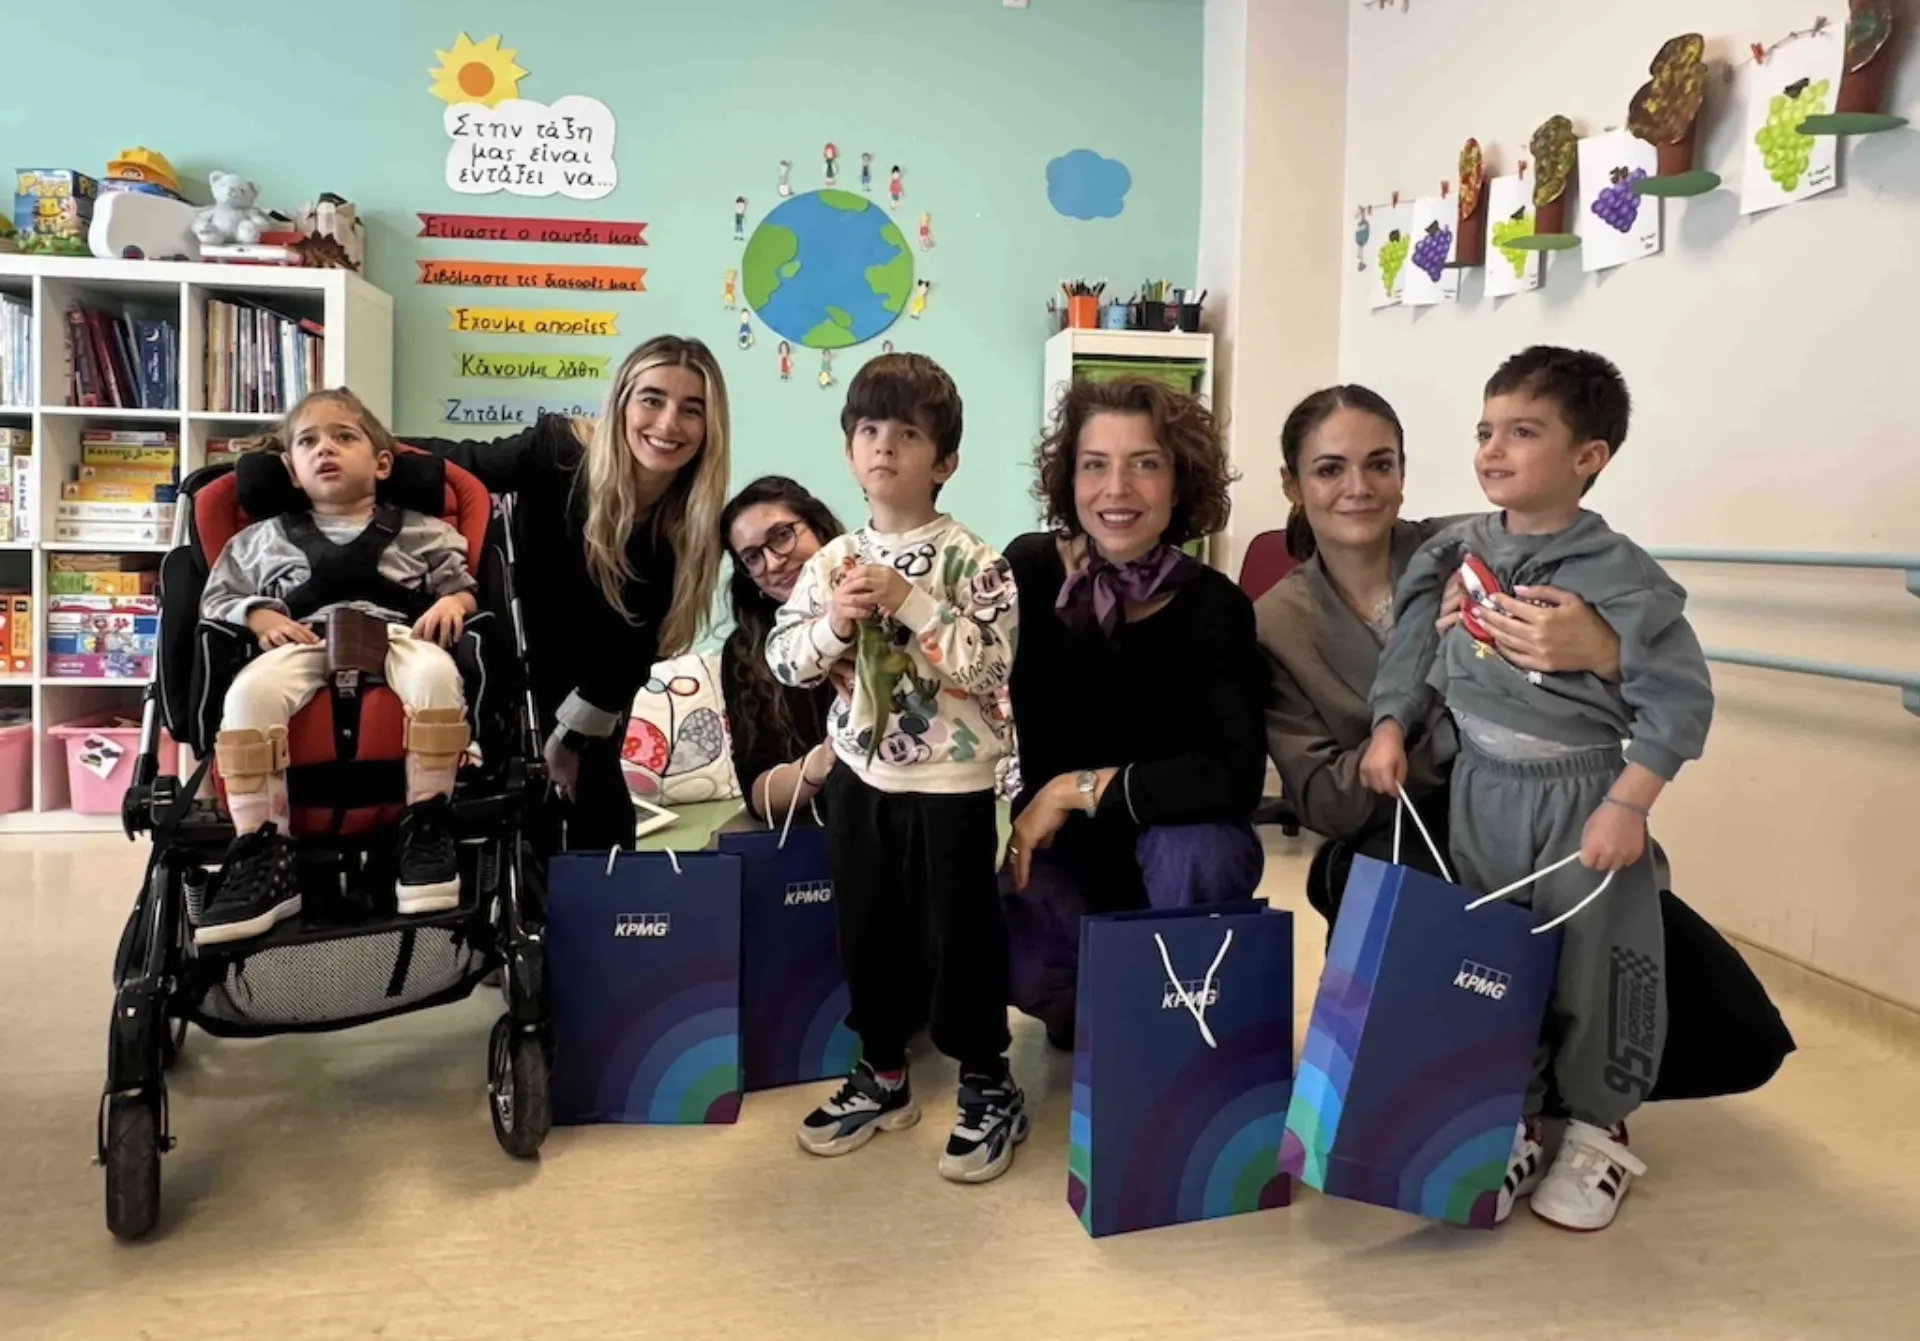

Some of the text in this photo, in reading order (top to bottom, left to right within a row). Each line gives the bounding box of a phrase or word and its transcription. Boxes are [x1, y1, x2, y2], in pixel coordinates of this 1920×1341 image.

[453, 113, 594, 143] Στην τάξη
[471, 142, 593, 167] μας είναι
[459, 164, 544, 185] εντάξει
[517, 229, 530, 240] ο
[608, 233, 639, 245] μας
[516, 273, 539, 288] τις
[609, 277, 637, 291] μας
[534, 318, 609, 335] απορίες
[461, 353, 600, 378] Κάνουμε λάθη
[446, 398, 525, 422] Ζητάμε
[783, 888, 832, 906] KPMG
[614, 922, 667, 937] KPMG
[1453, 971, 1507, 1000] KPMG
[1603, 1045, 1653, 1100] 95
